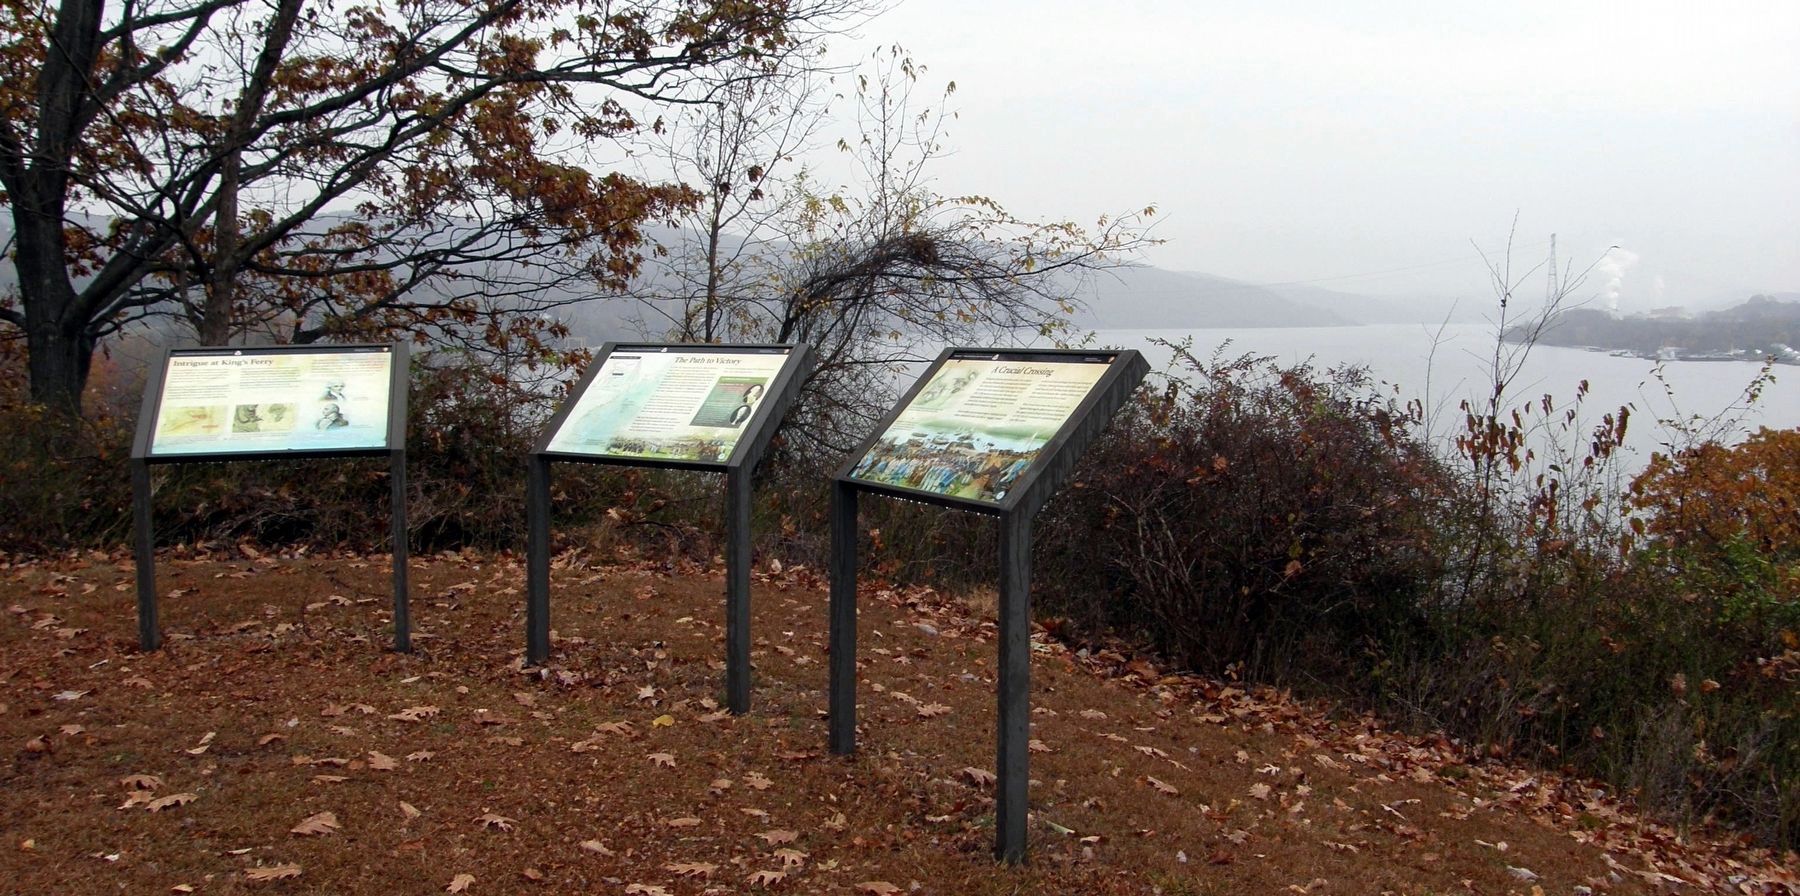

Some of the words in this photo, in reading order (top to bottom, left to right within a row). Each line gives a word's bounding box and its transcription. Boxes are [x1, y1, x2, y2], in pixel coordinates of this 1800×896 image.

[173, 360, 208, 368] Intrigue
[221, 359, 248, 367] King's
[251, 358, 273, 366] Ferry
[715, 358, 742, 366] Victory
[991, 366, 999, 374] A
[999, 365, 1025, 375] Crucial
[1023, 366, 1055, 378] Crossing
